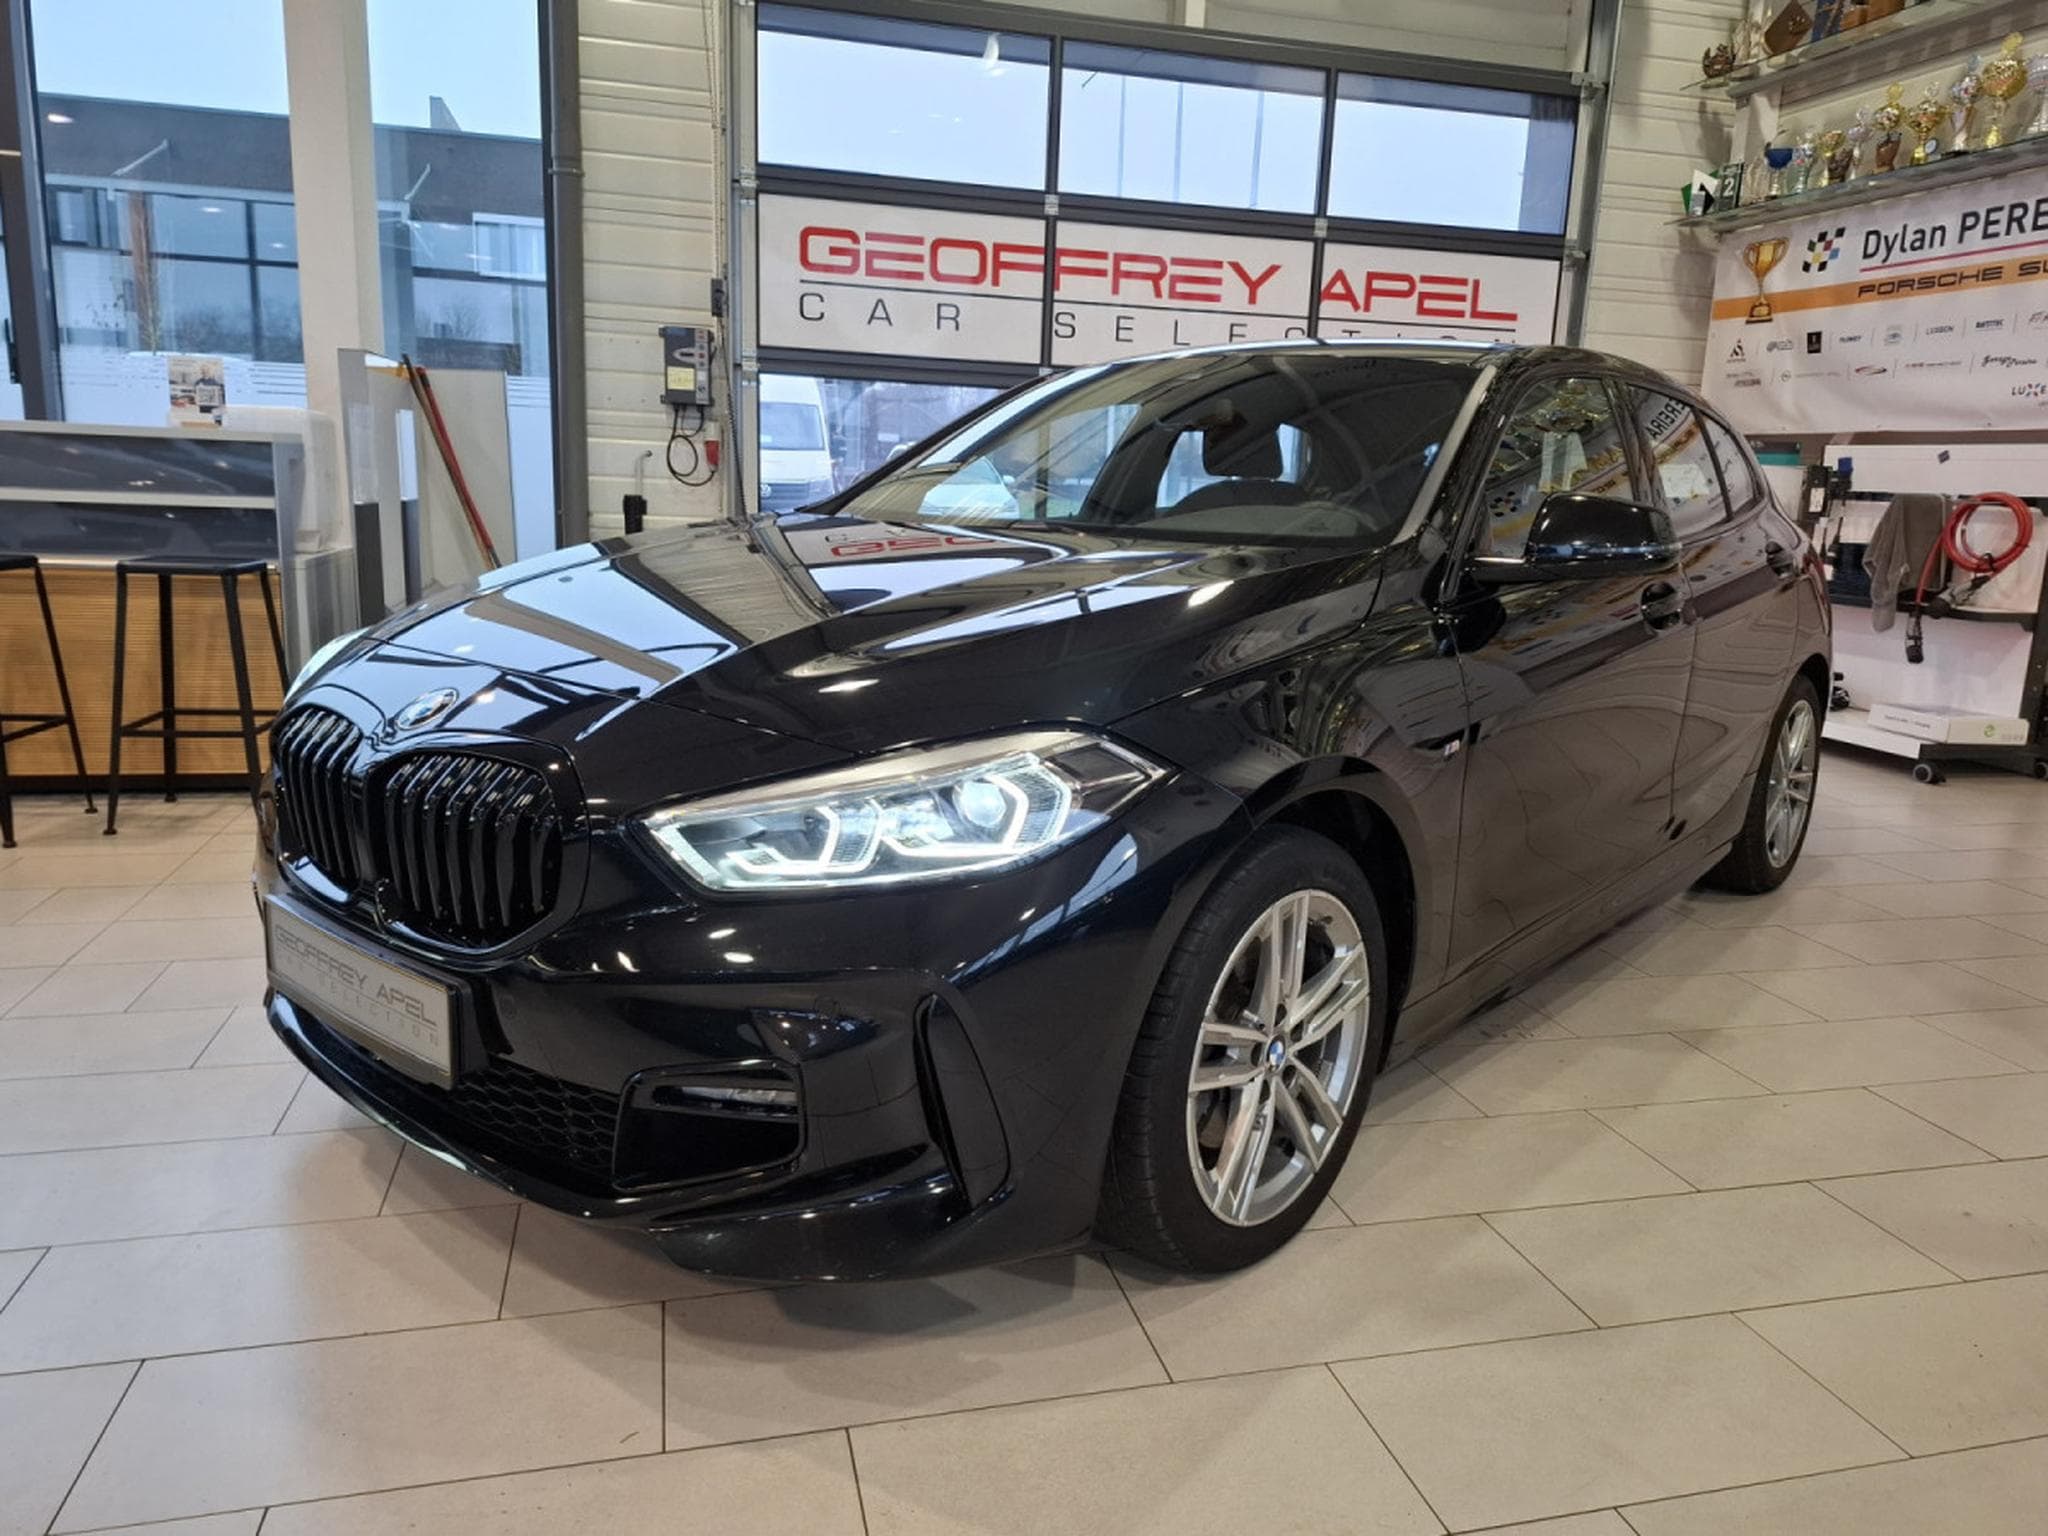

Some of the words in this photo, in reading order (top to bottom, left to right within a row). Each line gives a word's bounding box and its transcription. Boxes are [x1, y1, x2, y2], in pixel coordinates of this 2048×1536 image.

[1861, 223, 1947, 264] Dylan
[1957, 197, 2048, 244] PERE
[799, 226, 1282, 305] GEOFFREY
[1319, 268, 1519, 322] APEL
[1857, 266, 2004, 298] PORSCHE
[799, 292, 961, 331] CAR
[376, 982, 437, 1027] APEL
